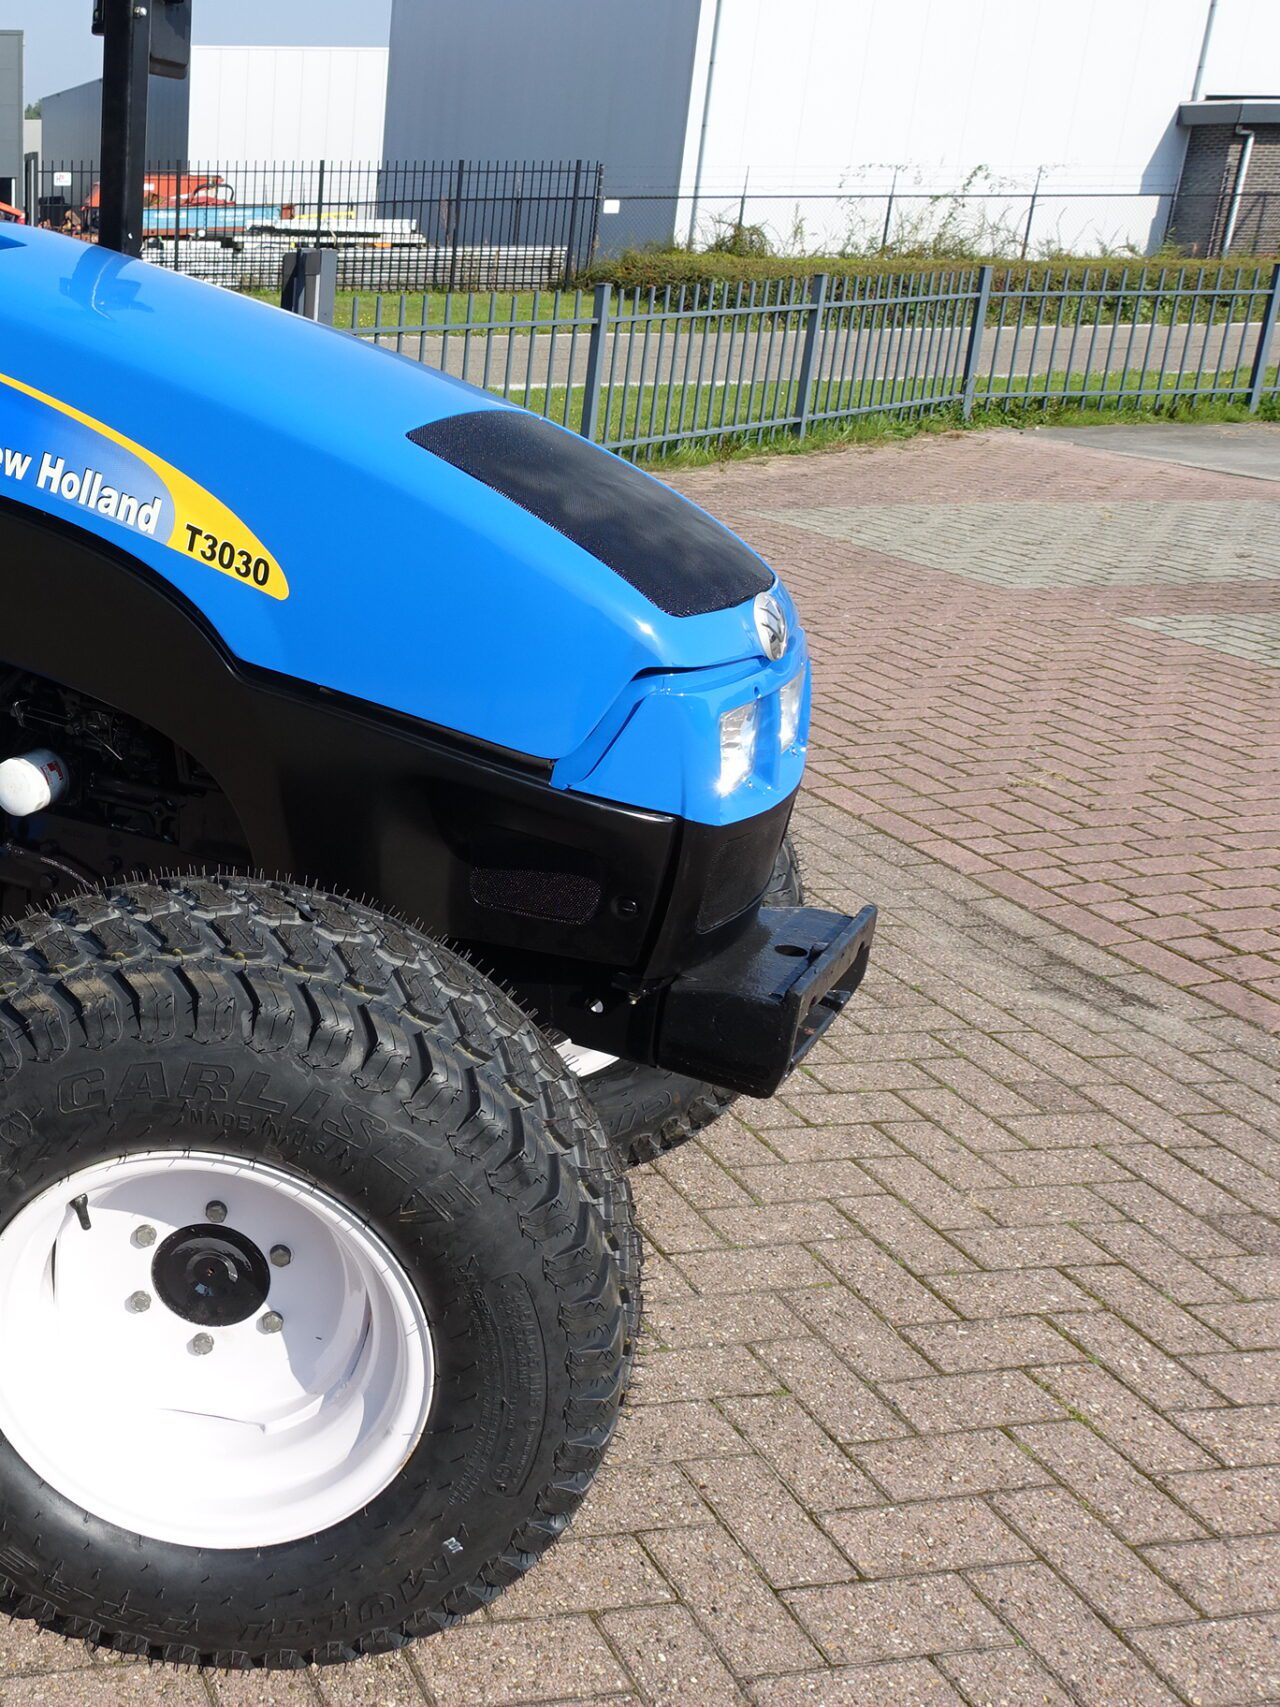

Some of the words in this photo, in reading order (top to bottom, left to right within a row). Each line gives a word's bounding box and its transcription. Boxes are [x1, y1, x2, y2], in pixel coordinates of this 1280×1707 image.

[36, 452, 162, 535] Holland
[185, 523, 271, 587] T3030
[57, 1061, 482, 1223] CARLISLE
[190, 1108, 251, 1130] MADE
